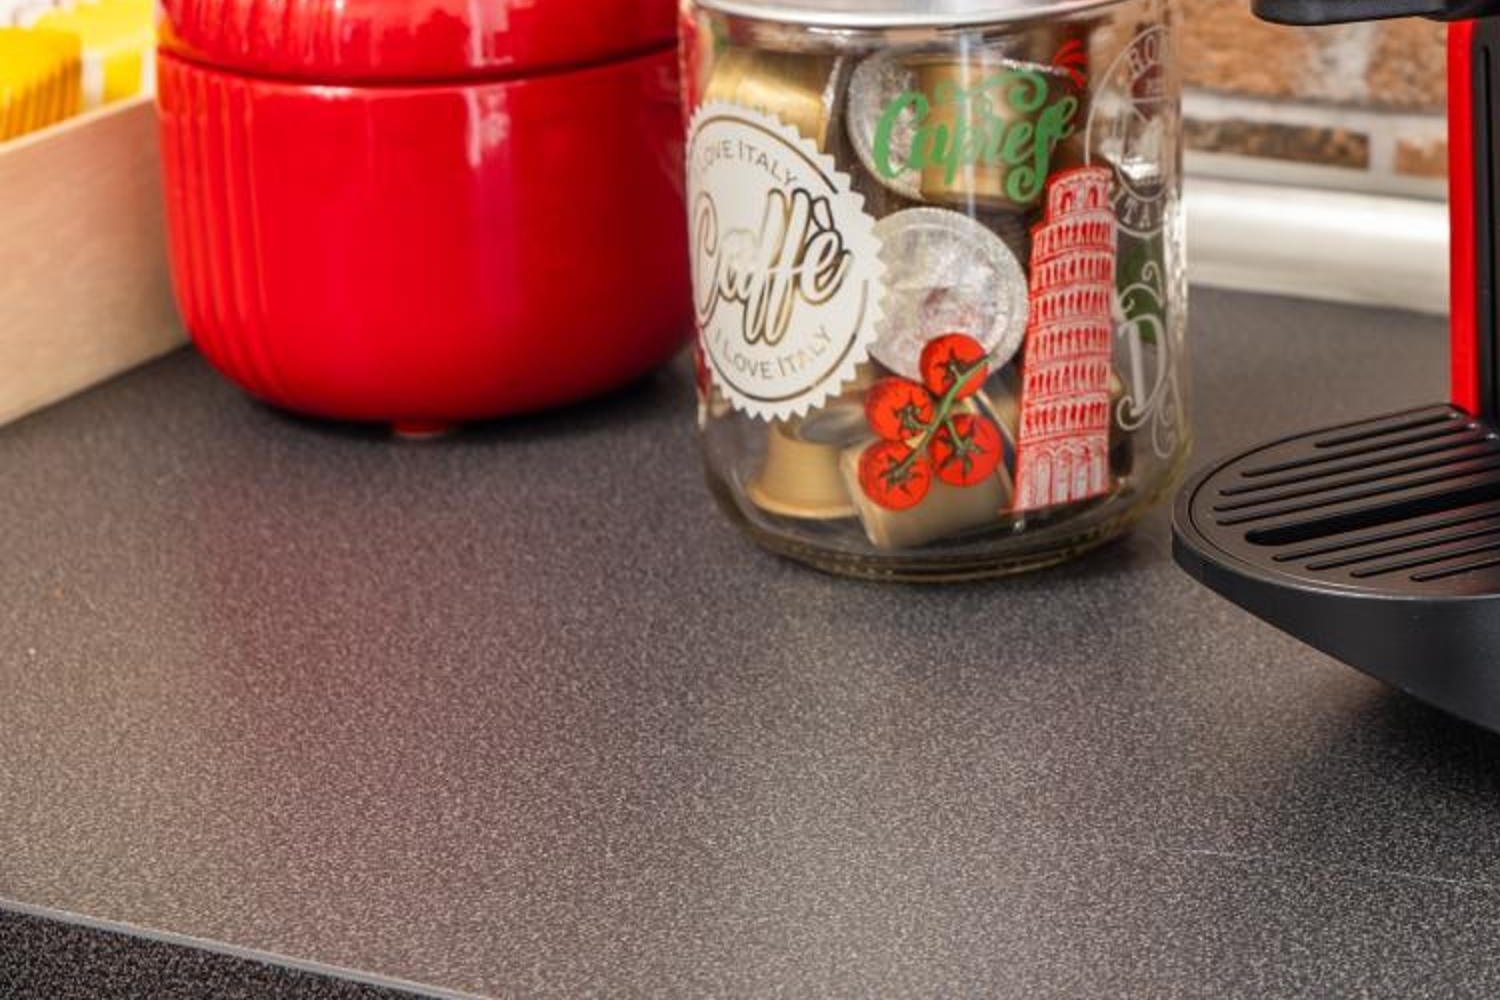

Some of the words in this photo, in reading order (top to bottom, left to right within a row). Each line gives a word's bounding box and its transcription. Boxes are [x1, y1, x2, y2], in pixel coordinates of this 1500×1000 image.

[737, 139, 798, 186] ITALY
[692, 187, 852, 346] Caffè
[722, 342, 774, 381] LOVE
[776, 324, 832, 378] ITALY
